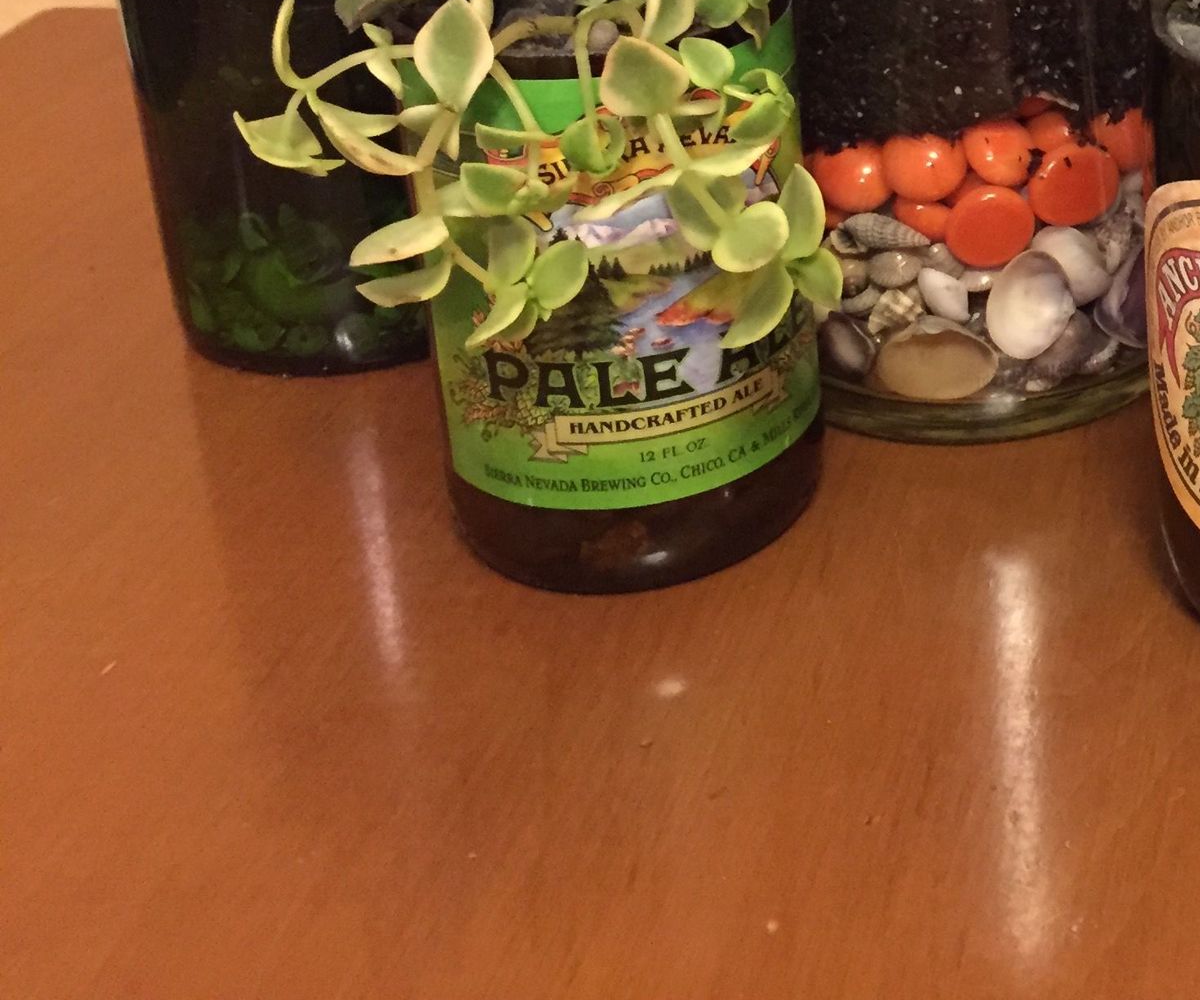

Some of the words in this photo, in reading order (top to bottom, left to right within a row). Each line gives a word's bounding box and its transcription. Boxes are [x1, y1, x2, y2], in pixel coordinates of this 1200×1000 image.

[481, 347, 696, 409] PALE
[569, 396, 728, 435] HANDCRAFTED
[732, 377, 764, 404] ALE
[1154, 362, 1183, 450] Made
[1177, 446, 1200, 486] in
[525, 474, 579, 493] NEVADA
[581, 475, 647, 493] BREWING
[728, 445, 748, 464] CA
[640, 451, 656, 464] 12
